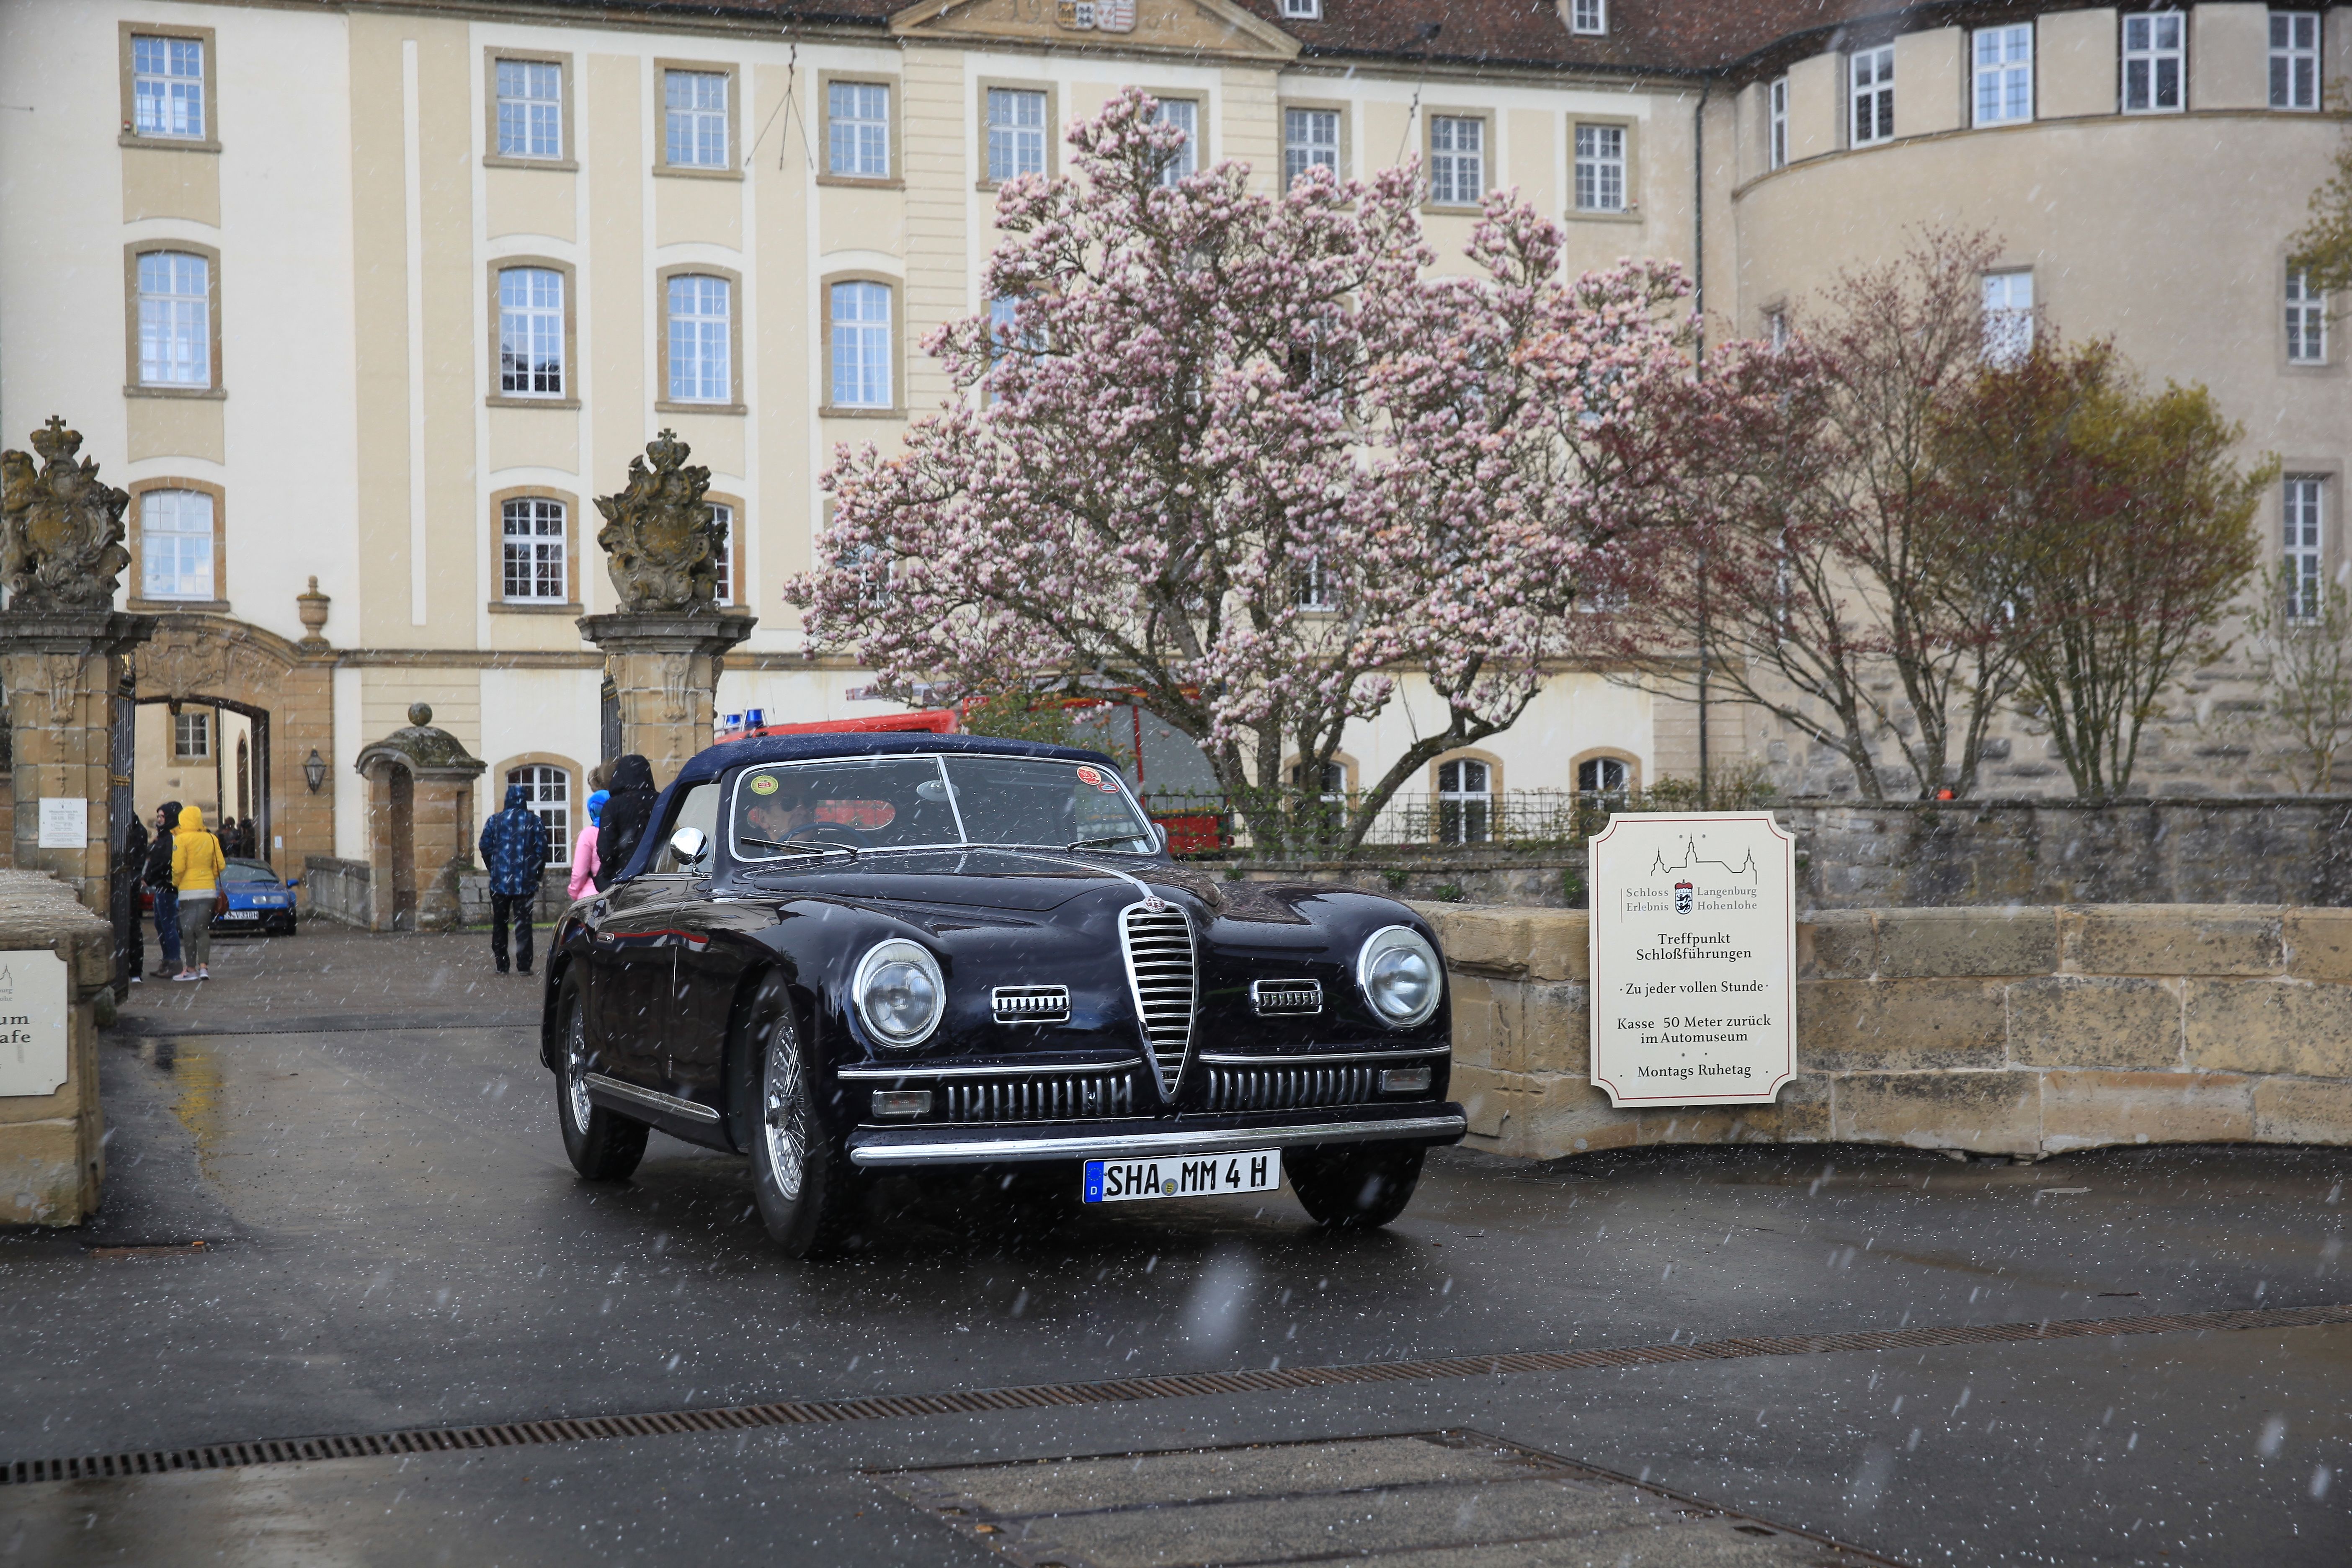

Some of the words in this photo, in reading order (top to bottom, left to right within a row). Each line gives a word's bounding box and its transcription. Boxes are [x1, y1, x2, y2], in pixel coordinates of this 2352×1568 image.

[1626, 887, 1669, 897] Schloss
[1697, 886, 1757, 898] Langenburg
[1627, 902, 1669, 911] Erlebnis
[1697, 900, 1757, 910] Hohenlohe
[1657, 932, 1731, 947] Treffpunkt
[1636, 948, 1752, 962] Schloßführungen
[1626, 983, 1642, 994] Zu
[1645, 982, 1676, 998] jeder
[1679, 981, 1718, 993] vollen
[1721, 980, 1764, 992] Stunde
[1617, 1018, 1655, 1029] Kasse
[1663, 1016, 1680, 1028] 50
[1684, 1016, 1723, 1028] Meter
[1727, 1014, 1772, 1027] zurück
[0, 1029, 31, 1044] afe
[1640, 1033, 1658, 1044] im
[1660, 1032, 1749, 1044] Automuseum
[1638, 1066, 1694, 1080] Montags
[1698, 1063, 1751, 1078] Ruhetag
[1106, 1163, 1161, 1196] SHA
[1181, 1159, 1217, 1192] MM
[1225, 1158, 1240, 1189] 4
[1250, 1155, 1266, 1187] H
[1090, 1186, 1097, 1196] D
